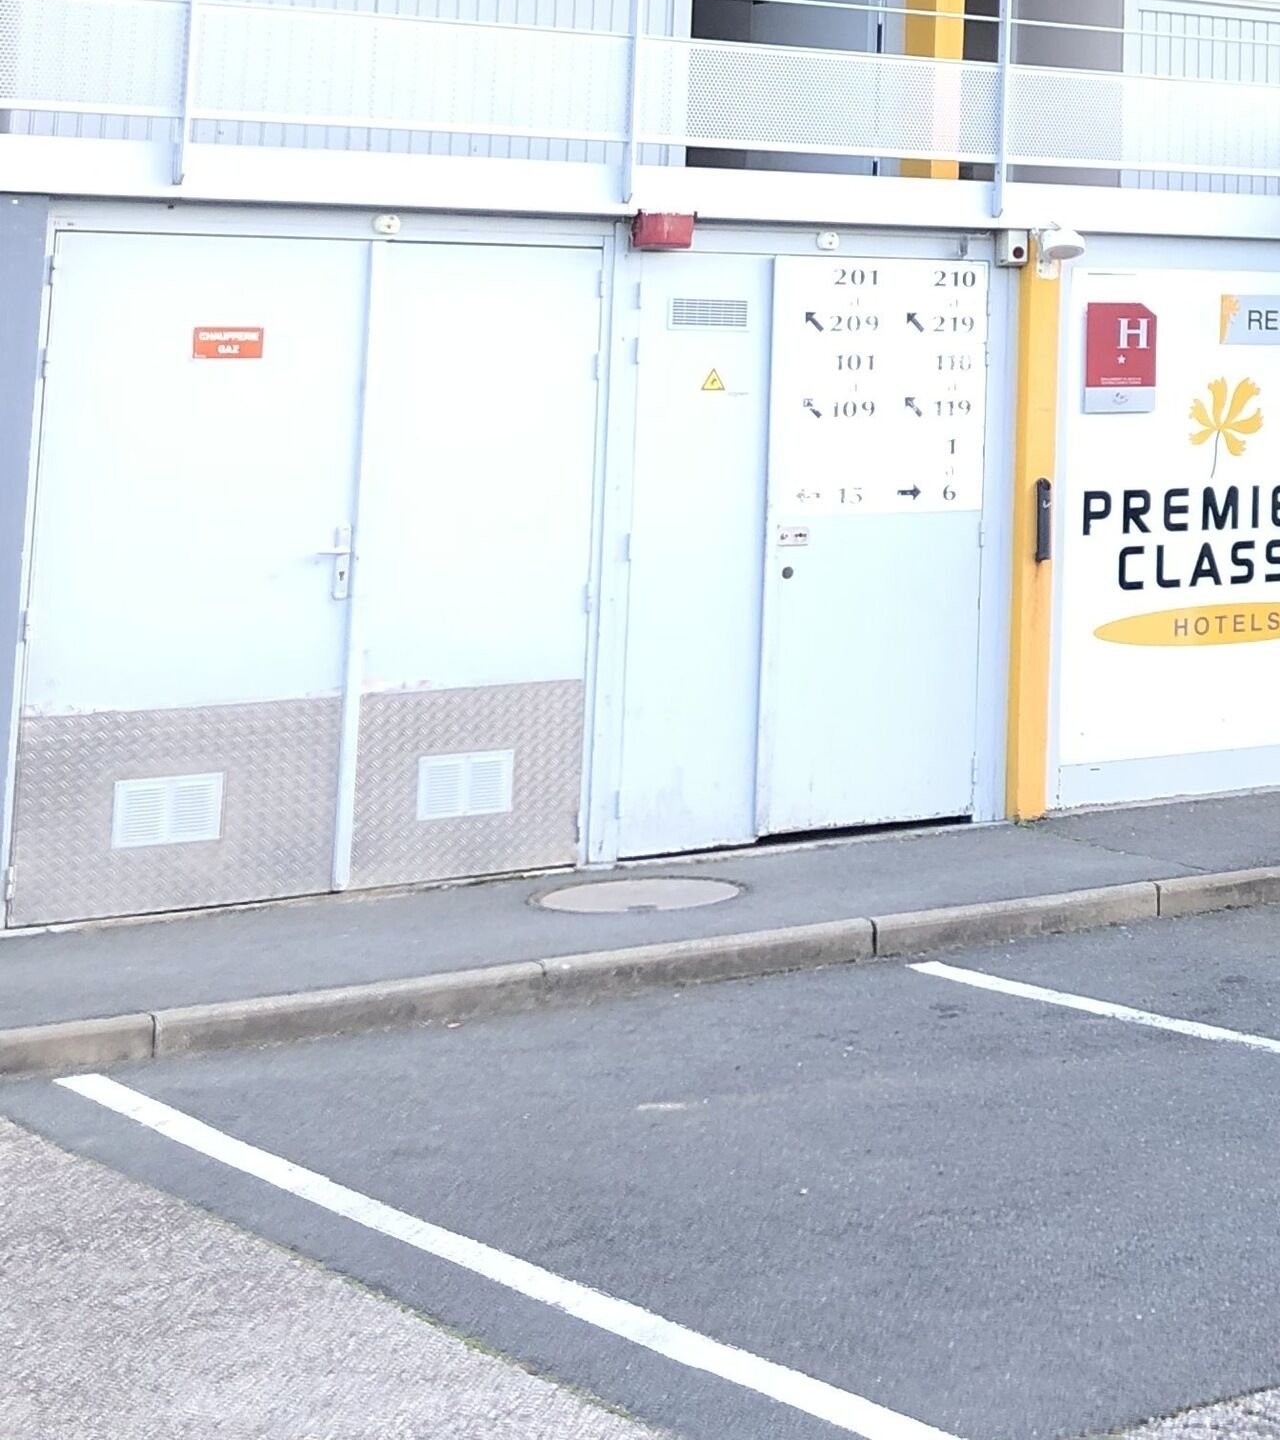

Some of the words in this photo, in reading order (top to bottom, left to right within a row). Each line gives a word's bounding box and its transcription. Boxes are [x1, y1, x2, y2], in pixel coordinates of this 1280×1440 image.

[834, 269, 878, 285] 201
[934, 270, 976, 287] 210
[830, 315, 879, 331] 209
[933, 316, 975, 332] 219
[1116, 318, 1150, 349] H
[837, 354, 875, 370] 101
[937, 354, 973, 370] 110
[834, 401, 876, 418] 109
[935, 400, 972, 416] 119
[948, 439, 956, 454] 1
[942, 485, 957, 500] 6
[1173, 612, 1280, 637] HOTELS
